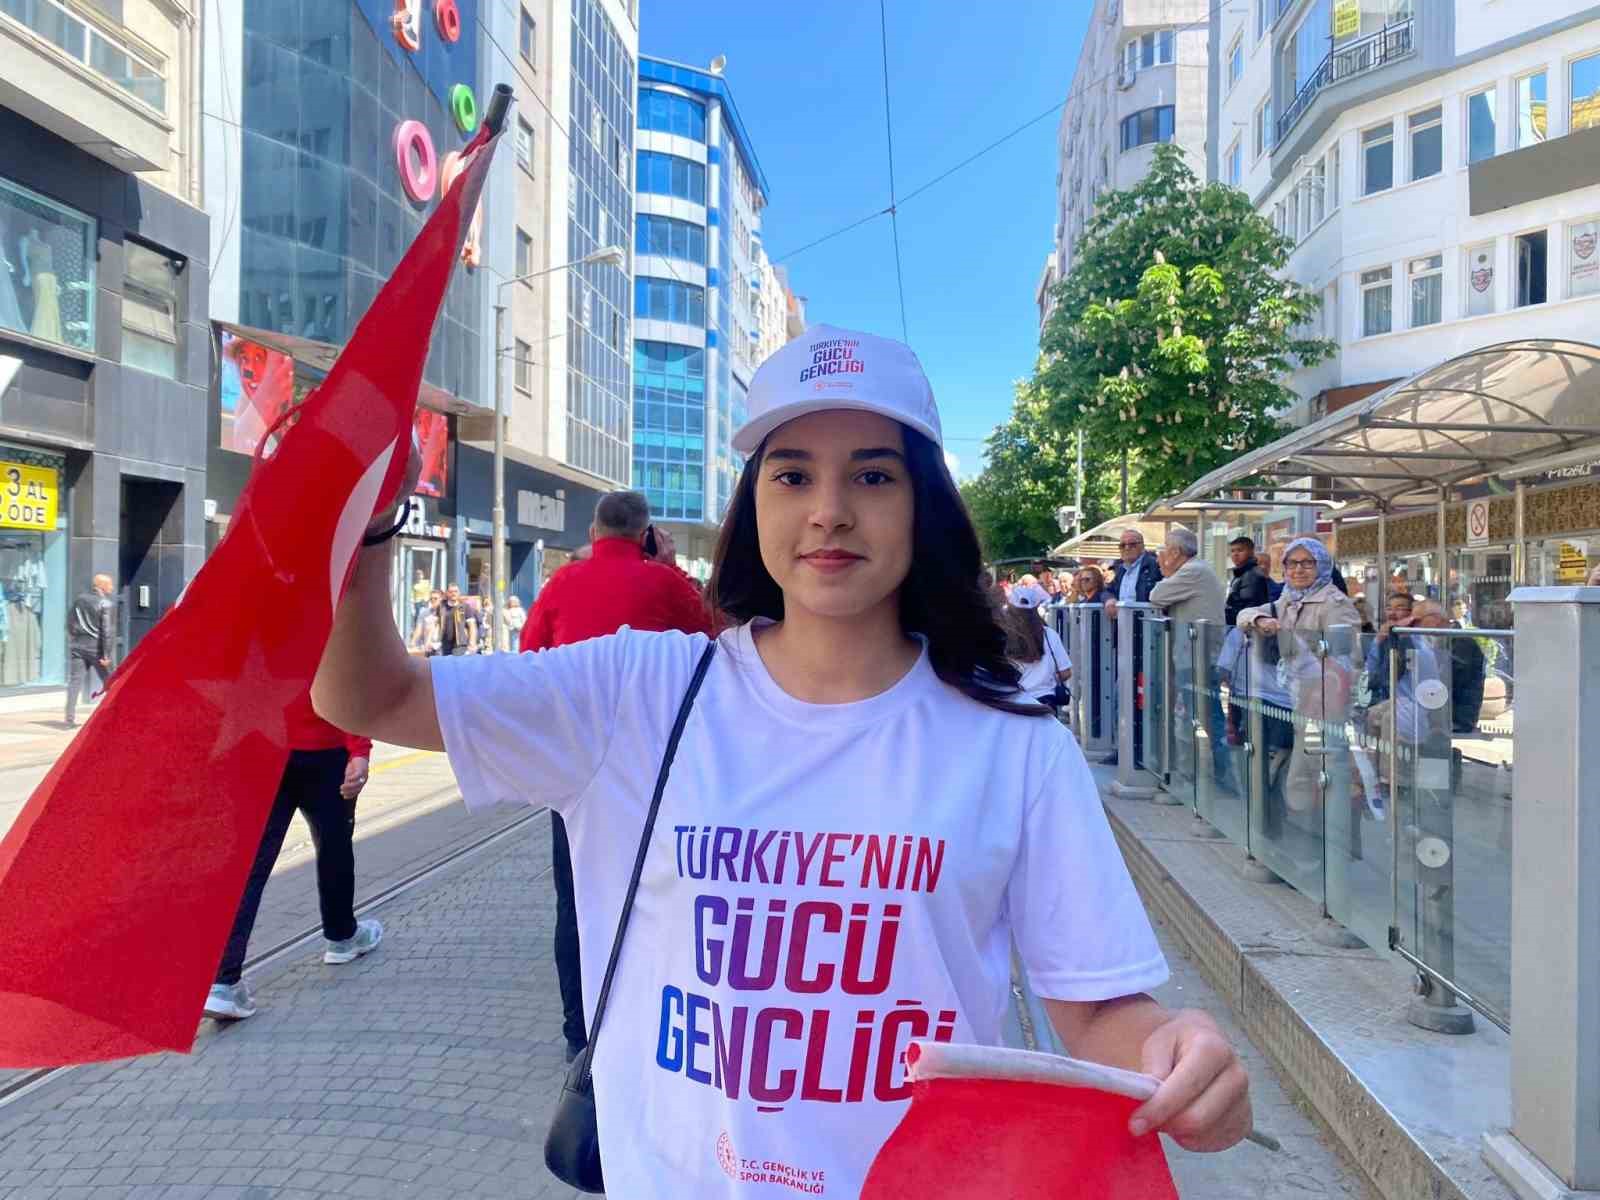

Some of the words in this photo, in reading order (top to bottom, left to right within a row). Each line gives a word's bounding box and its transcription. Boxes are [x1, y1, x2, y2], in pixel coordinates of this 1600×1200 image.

[7, 468, 21, 497] 3
[26, 480, 48, 500] AL
[674, 825, 945, 893] TÜRKİYE'NİN
[694, 894, 902, 995] GÜCÜ
[740, 1172, 767, 1183] SPOR
[741, 1159, 759, 1169] T.C.
[811, 1171, 825, 1181] VE
